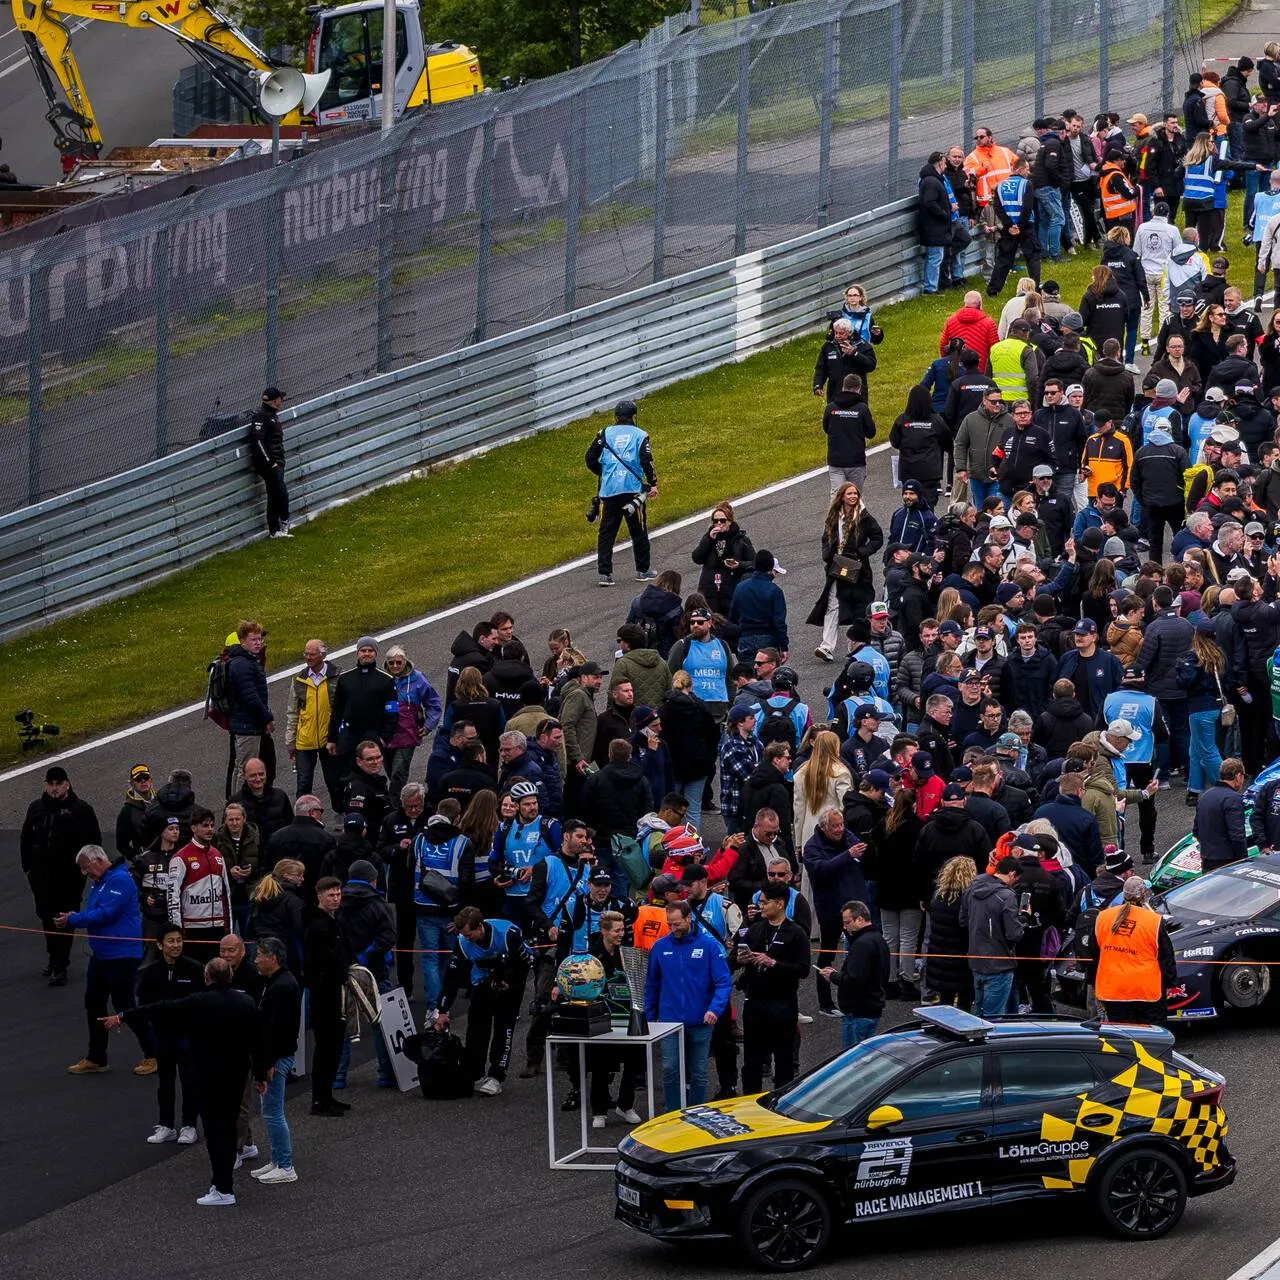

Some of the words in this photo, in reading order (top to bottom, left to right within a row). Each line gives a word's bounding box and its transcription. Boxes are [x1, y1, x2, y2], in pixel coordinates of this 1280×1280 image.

[694, 668, 720, 677] MEDIA
[701, 681, 717, 690] 711
[512, 849, 532, 864] TV
[1235, 926, 1280, 937] FALKEN
[868, 1140, 909, 1150] RAVENOL
[999, 1140, 1089, 1160] LöhrGruppe
[854, 1176, 907, 1190] nürburgring
[855, 1196, 887, 1217] RACE
[889, 1183, 968, 1211] MANAGEMENT
